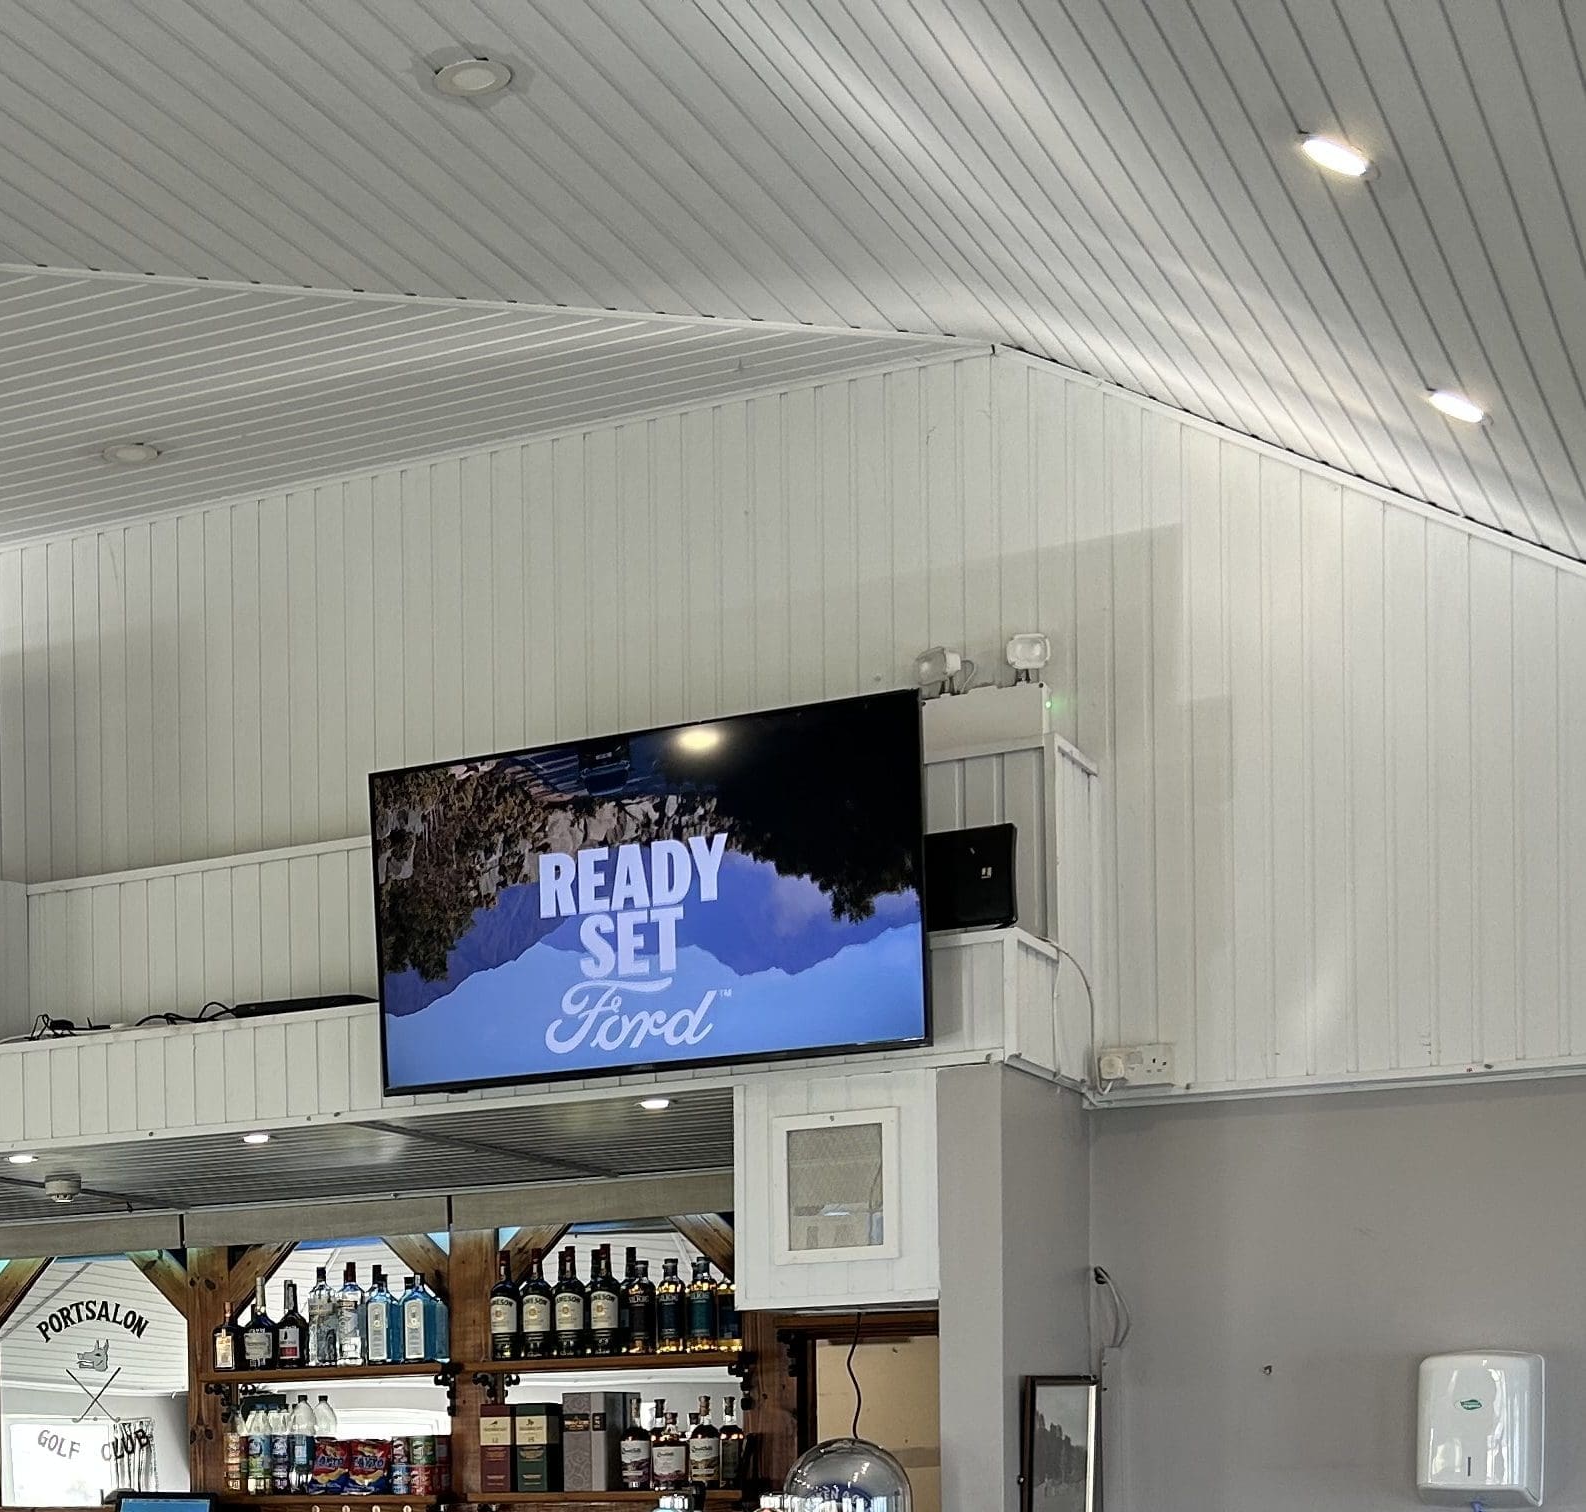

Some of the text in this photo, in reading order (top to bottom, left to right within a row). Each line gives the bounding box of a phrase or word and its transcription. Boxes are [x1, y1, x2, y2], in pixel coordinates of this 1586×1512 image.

[539, 833, 728, 919] READY
[579, 906, 685, 979] SET
[545, 977, 717, 1054] Ford
[36, 1300, 150, 1343] PORTSALON
[38, 1428, 151, 1462] GOLF CLUB
